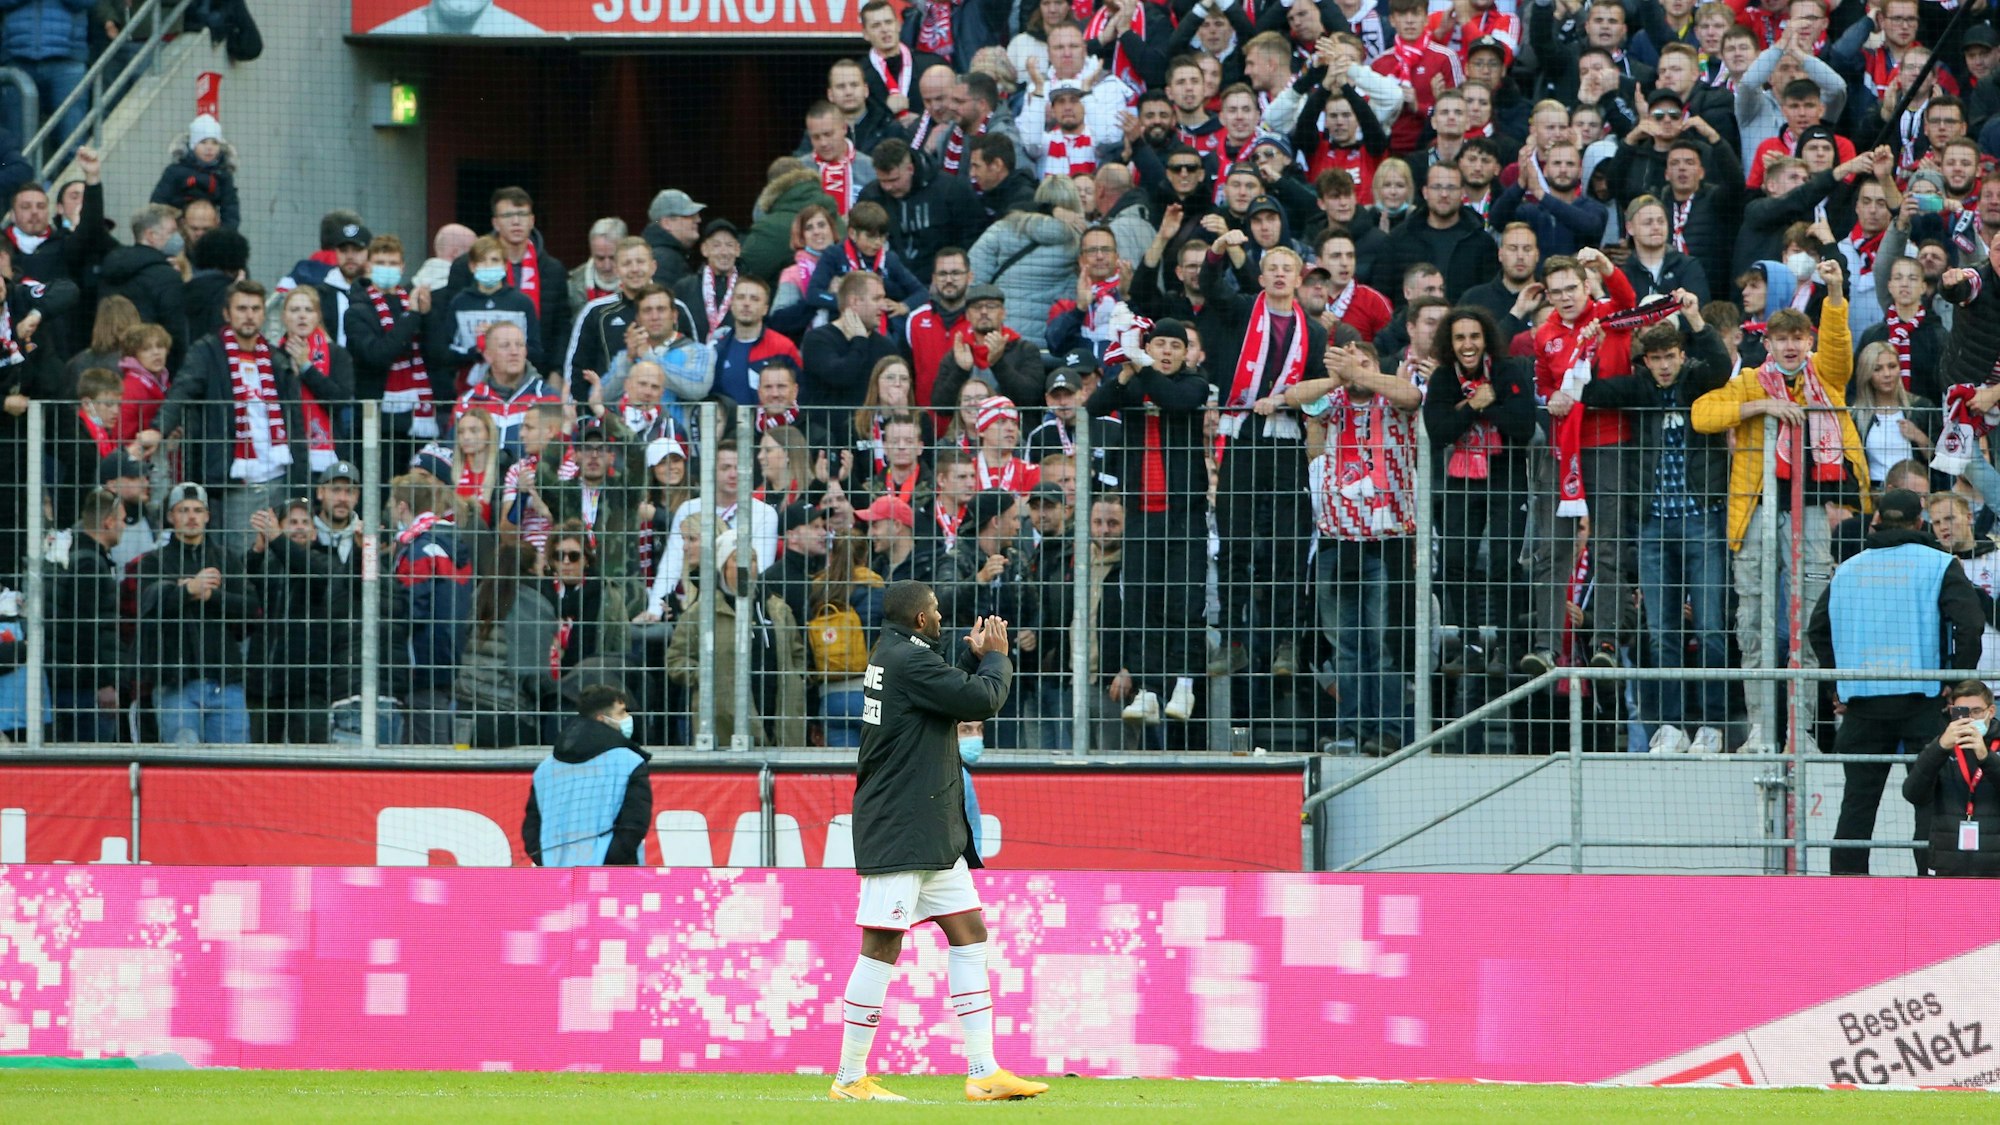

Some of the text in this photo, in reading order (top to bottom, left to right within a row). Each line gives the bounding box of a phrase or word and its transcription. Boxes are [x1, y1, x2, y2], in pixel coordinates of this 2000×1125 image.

[1809, 793, 1823, 817] 2
[1838, 992, 1942, 1045] Bestes
[1829, 1020, 1993, 1084] 5G-Netz
